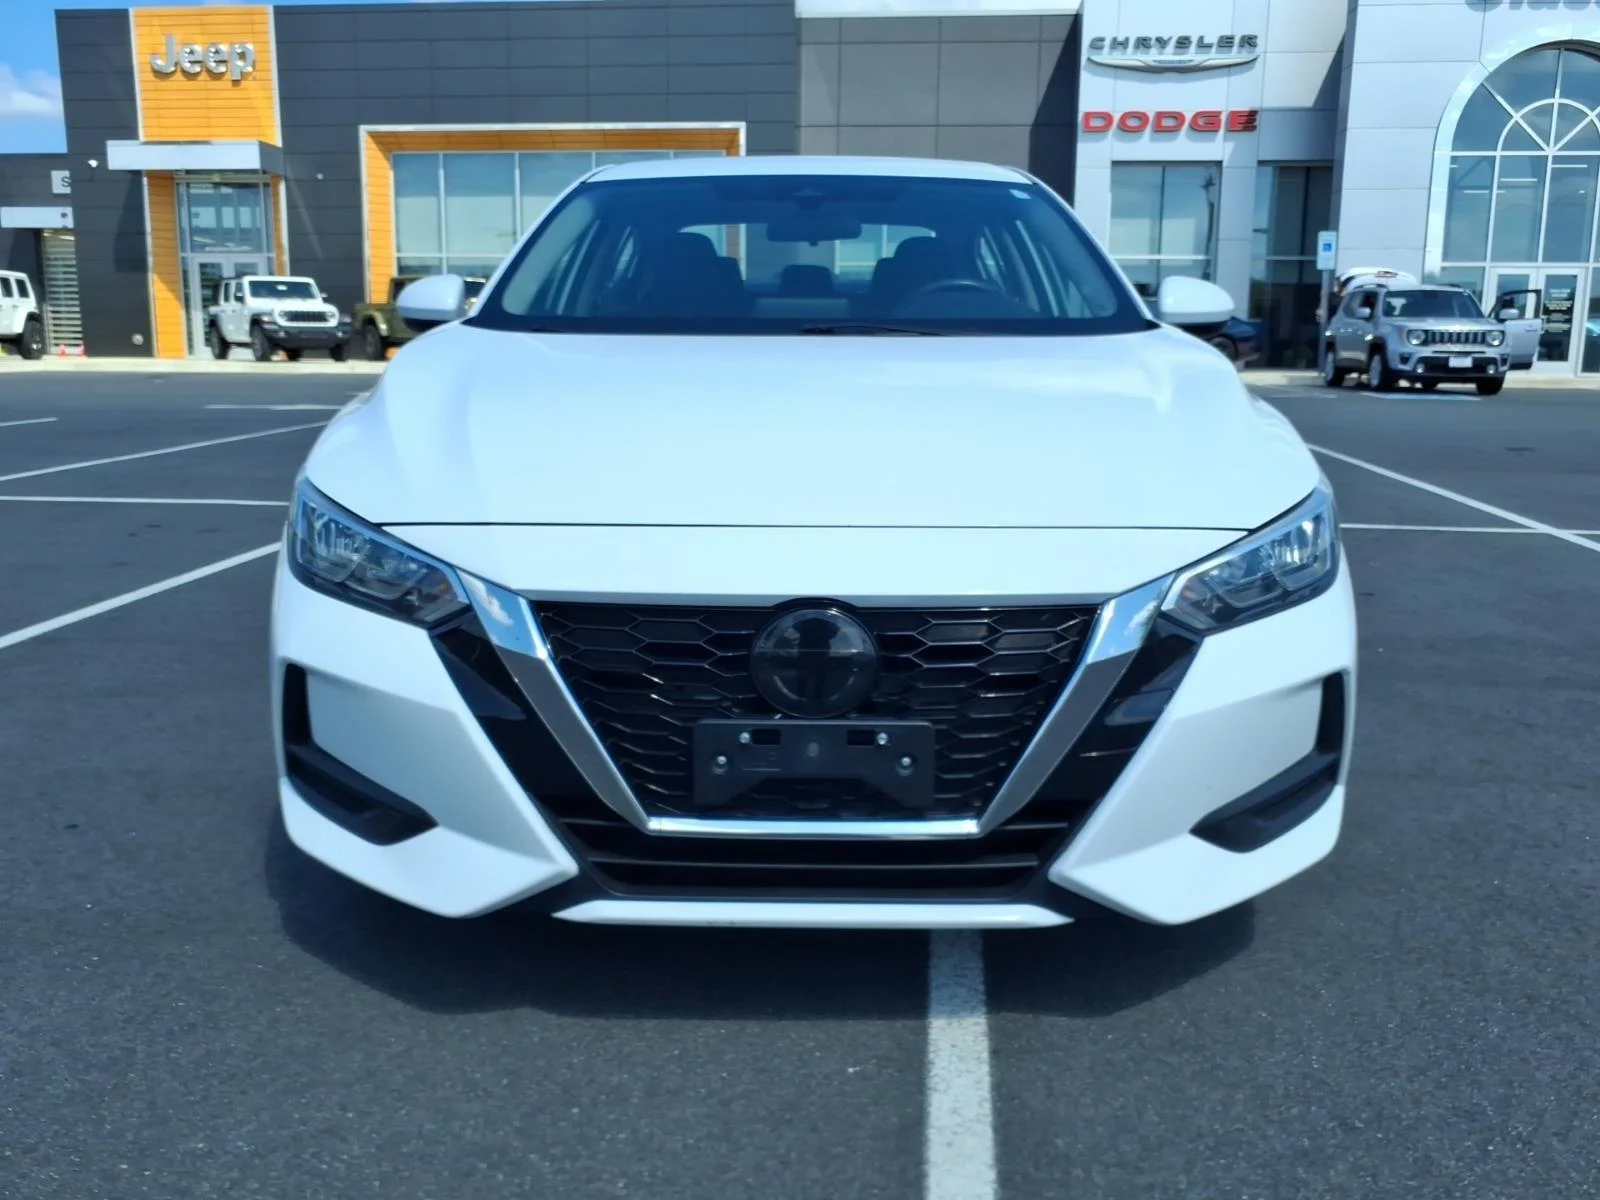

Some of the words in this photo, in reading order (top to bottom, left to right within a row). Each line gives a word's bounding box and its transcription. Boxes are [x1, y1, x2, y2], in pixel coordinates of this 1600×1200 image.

[1088, 35, 1258, 49] CHRYSLER
[150, 33, 254, 80] Jeep
[1082, 111, 1258, 132] DODGE
